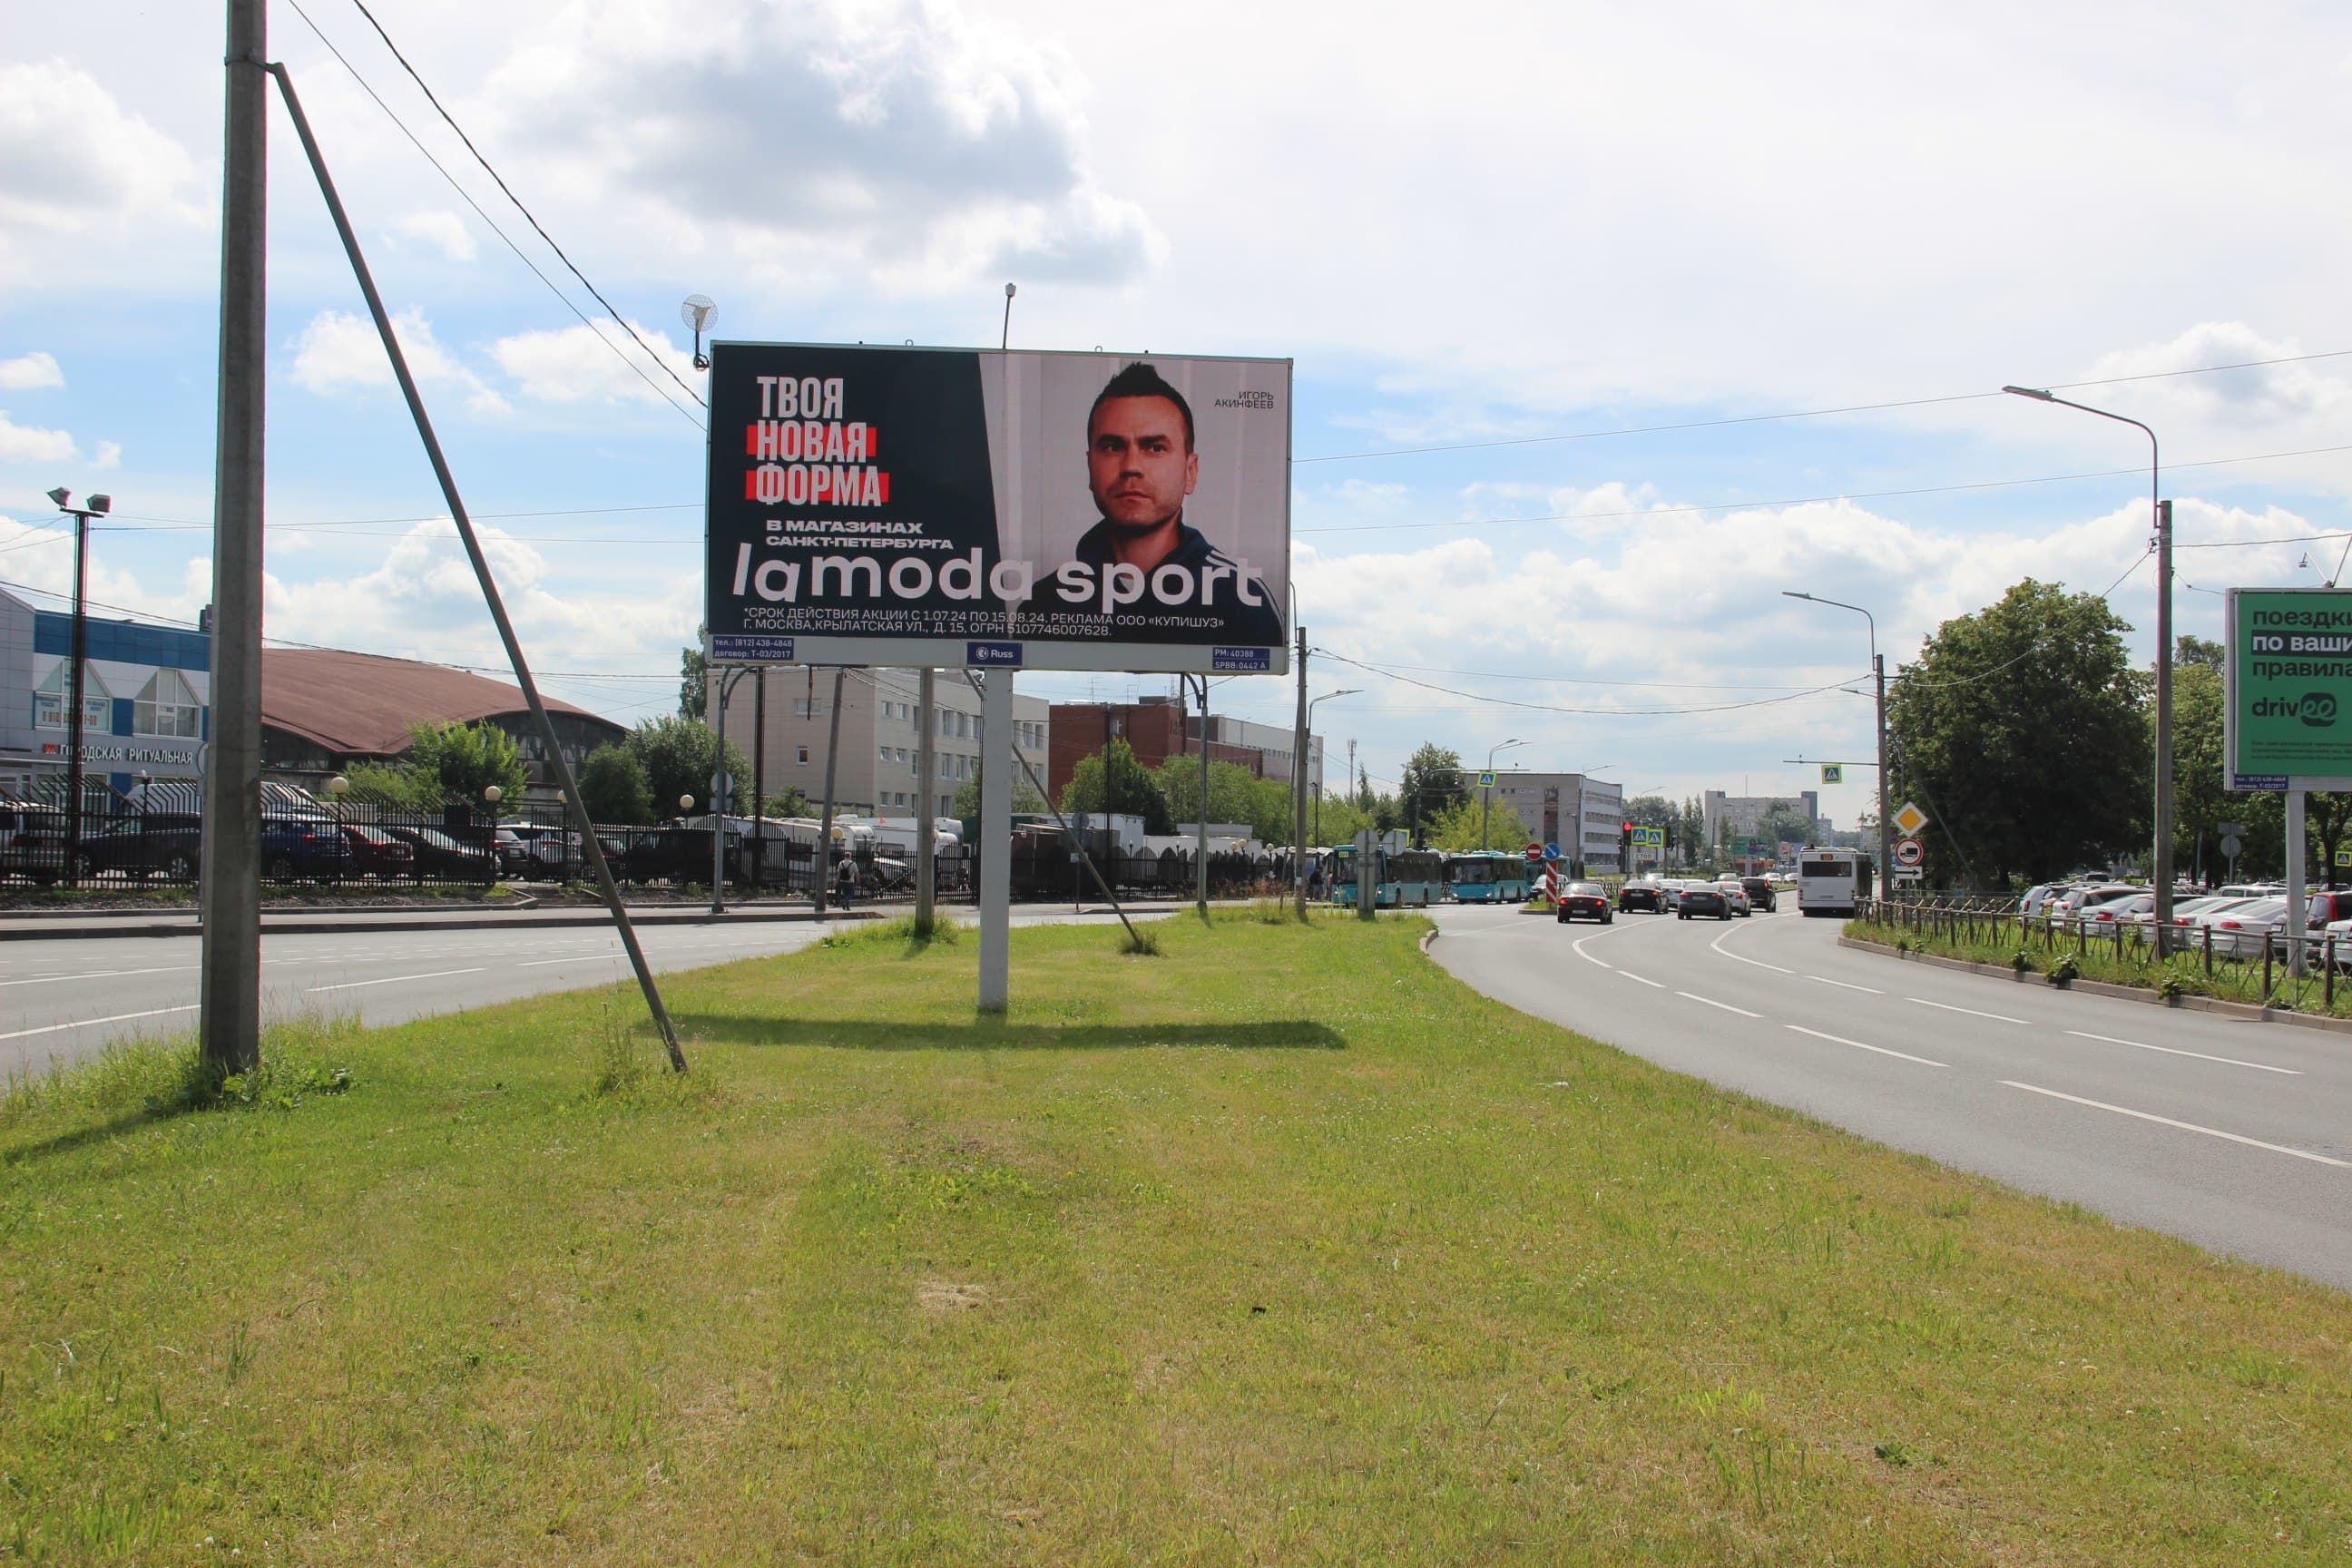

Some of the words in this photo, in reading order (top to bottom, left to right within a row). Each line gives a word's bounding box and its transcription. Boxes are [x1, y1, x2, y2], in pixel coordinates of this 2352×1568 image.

[757, 377, 844, 419] ТВОЯ
[1214, 399, 1274, 409] АКИНФЕЕВ
[1239, 391, 1274, 400] ИГОРЬ
[757, 420, 867, 463] НОВАЯ
[756, 463, 881, 506] ФОРМА
[766, 520, 782, 531] В
[786, 521, 923, 534] МАГАЗИНАХ
[766, 536, 954, 550] САНКТ-ПЕТЕРБУРГА
[733, 543, 1033, 603] lamoda
[1055, 558, 1263, 614] sport
[788, 606, 858, 620] ДЕЙСТВИЯ
[862, 609, 907, 622] АКЦИИ
[911, 610, 921, 621] С
[924, 611, 966, 622] 1.07.24
[970, 612, 988, 622] ПО
[1051, 613, 1113, 624] РЕКЛАМА
[1116, 615, 1146, 625] ООО
[1148, 616, 1225, 628] «КУПИШУЗ»
[744, 619, 752, 630] Г.
[933, 622, 946, 633] Д.
[950, 622, 967, 634] 15,
[970, 622, 1004, 633] ОГРН
[2252, 636, 2284, 652] по
[990, 649, 1014, 658] Russ
[2251, 693, 2337, 726] drivee
[60, 744, 122, 762] ГООДСКАЯ
[129, 749, 193, 764] РИТУАЛЬНАЯ
